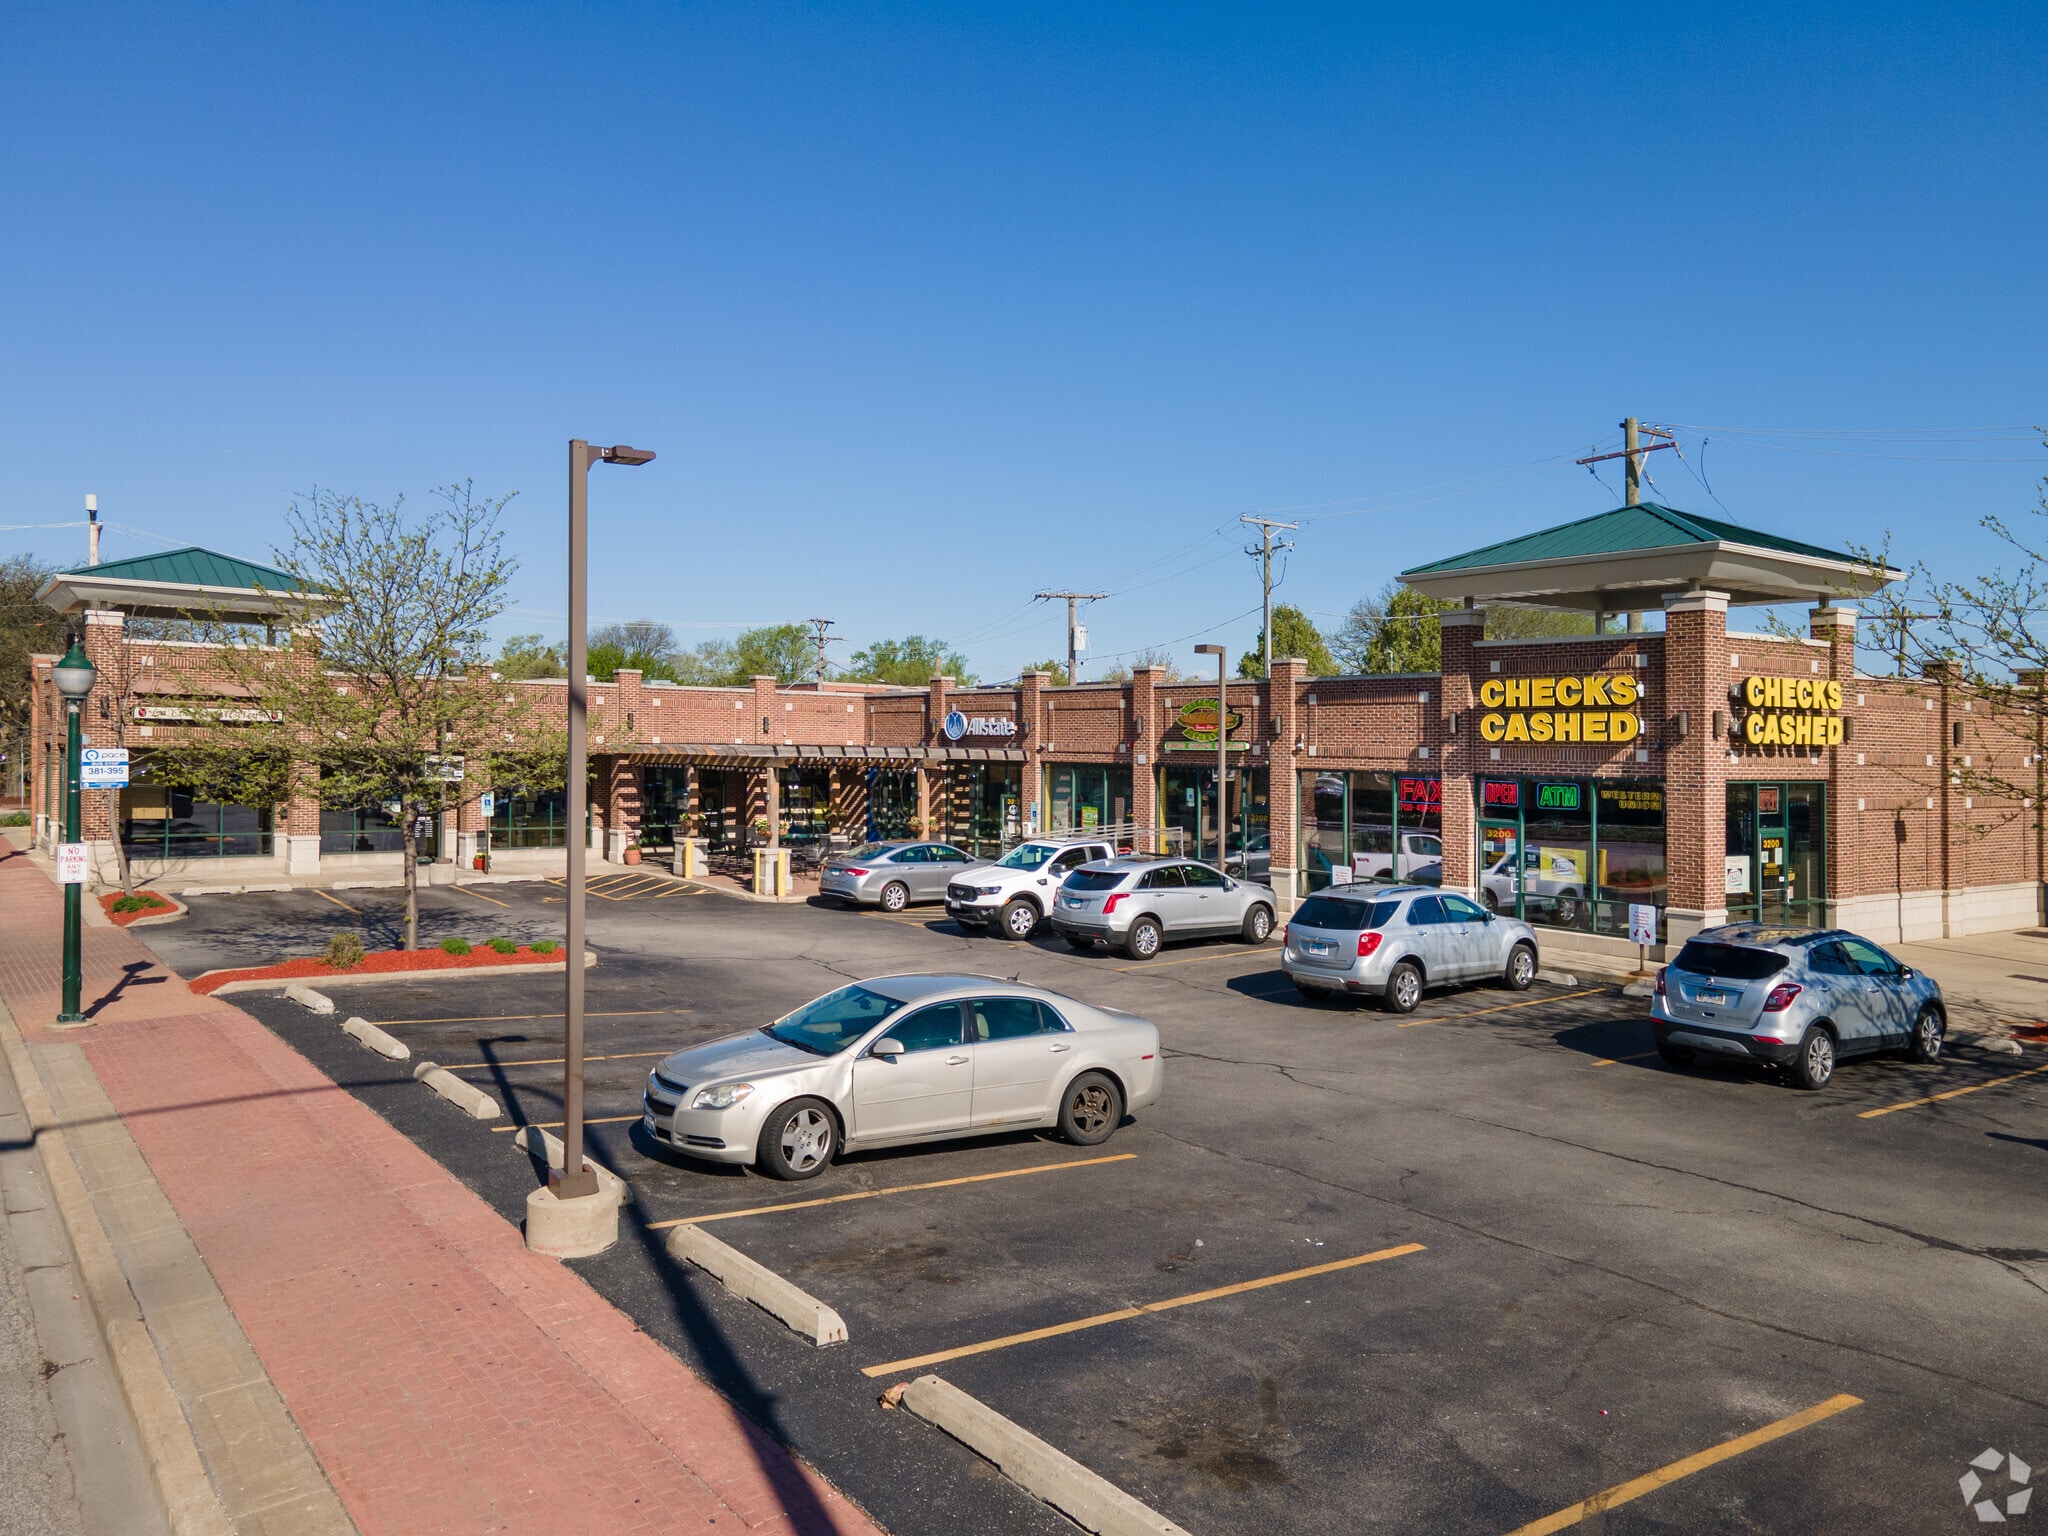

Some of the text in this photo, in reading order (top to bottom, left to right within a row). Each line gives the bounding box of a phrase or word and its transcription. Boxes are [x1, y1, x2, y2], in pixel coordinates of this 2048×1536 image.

[1481, 675, 1637, 707] CHECKS
[1746, 677, 1842, 710] CHECKS
[966, 717, 1016, 736] Allstate
[1481, 712, 1638, 741] CASHED
[1746, 713, 1842, 745] CASHED
[88, 767, 124, 775] 381-395
[1400, 780, 1442, 802] FAX
[1485, 783, 1518, 804] OPEN
[1540, 785, 1578, 806] ATM
[1601, 791, 1660, 801] WESTERN
[1618, 800, 1661, 810] UNION
[1486, 829, 1512, 838] 3200
[67, 847, 80, 855] NO
[1763, 839, 1780, 849] 3200
